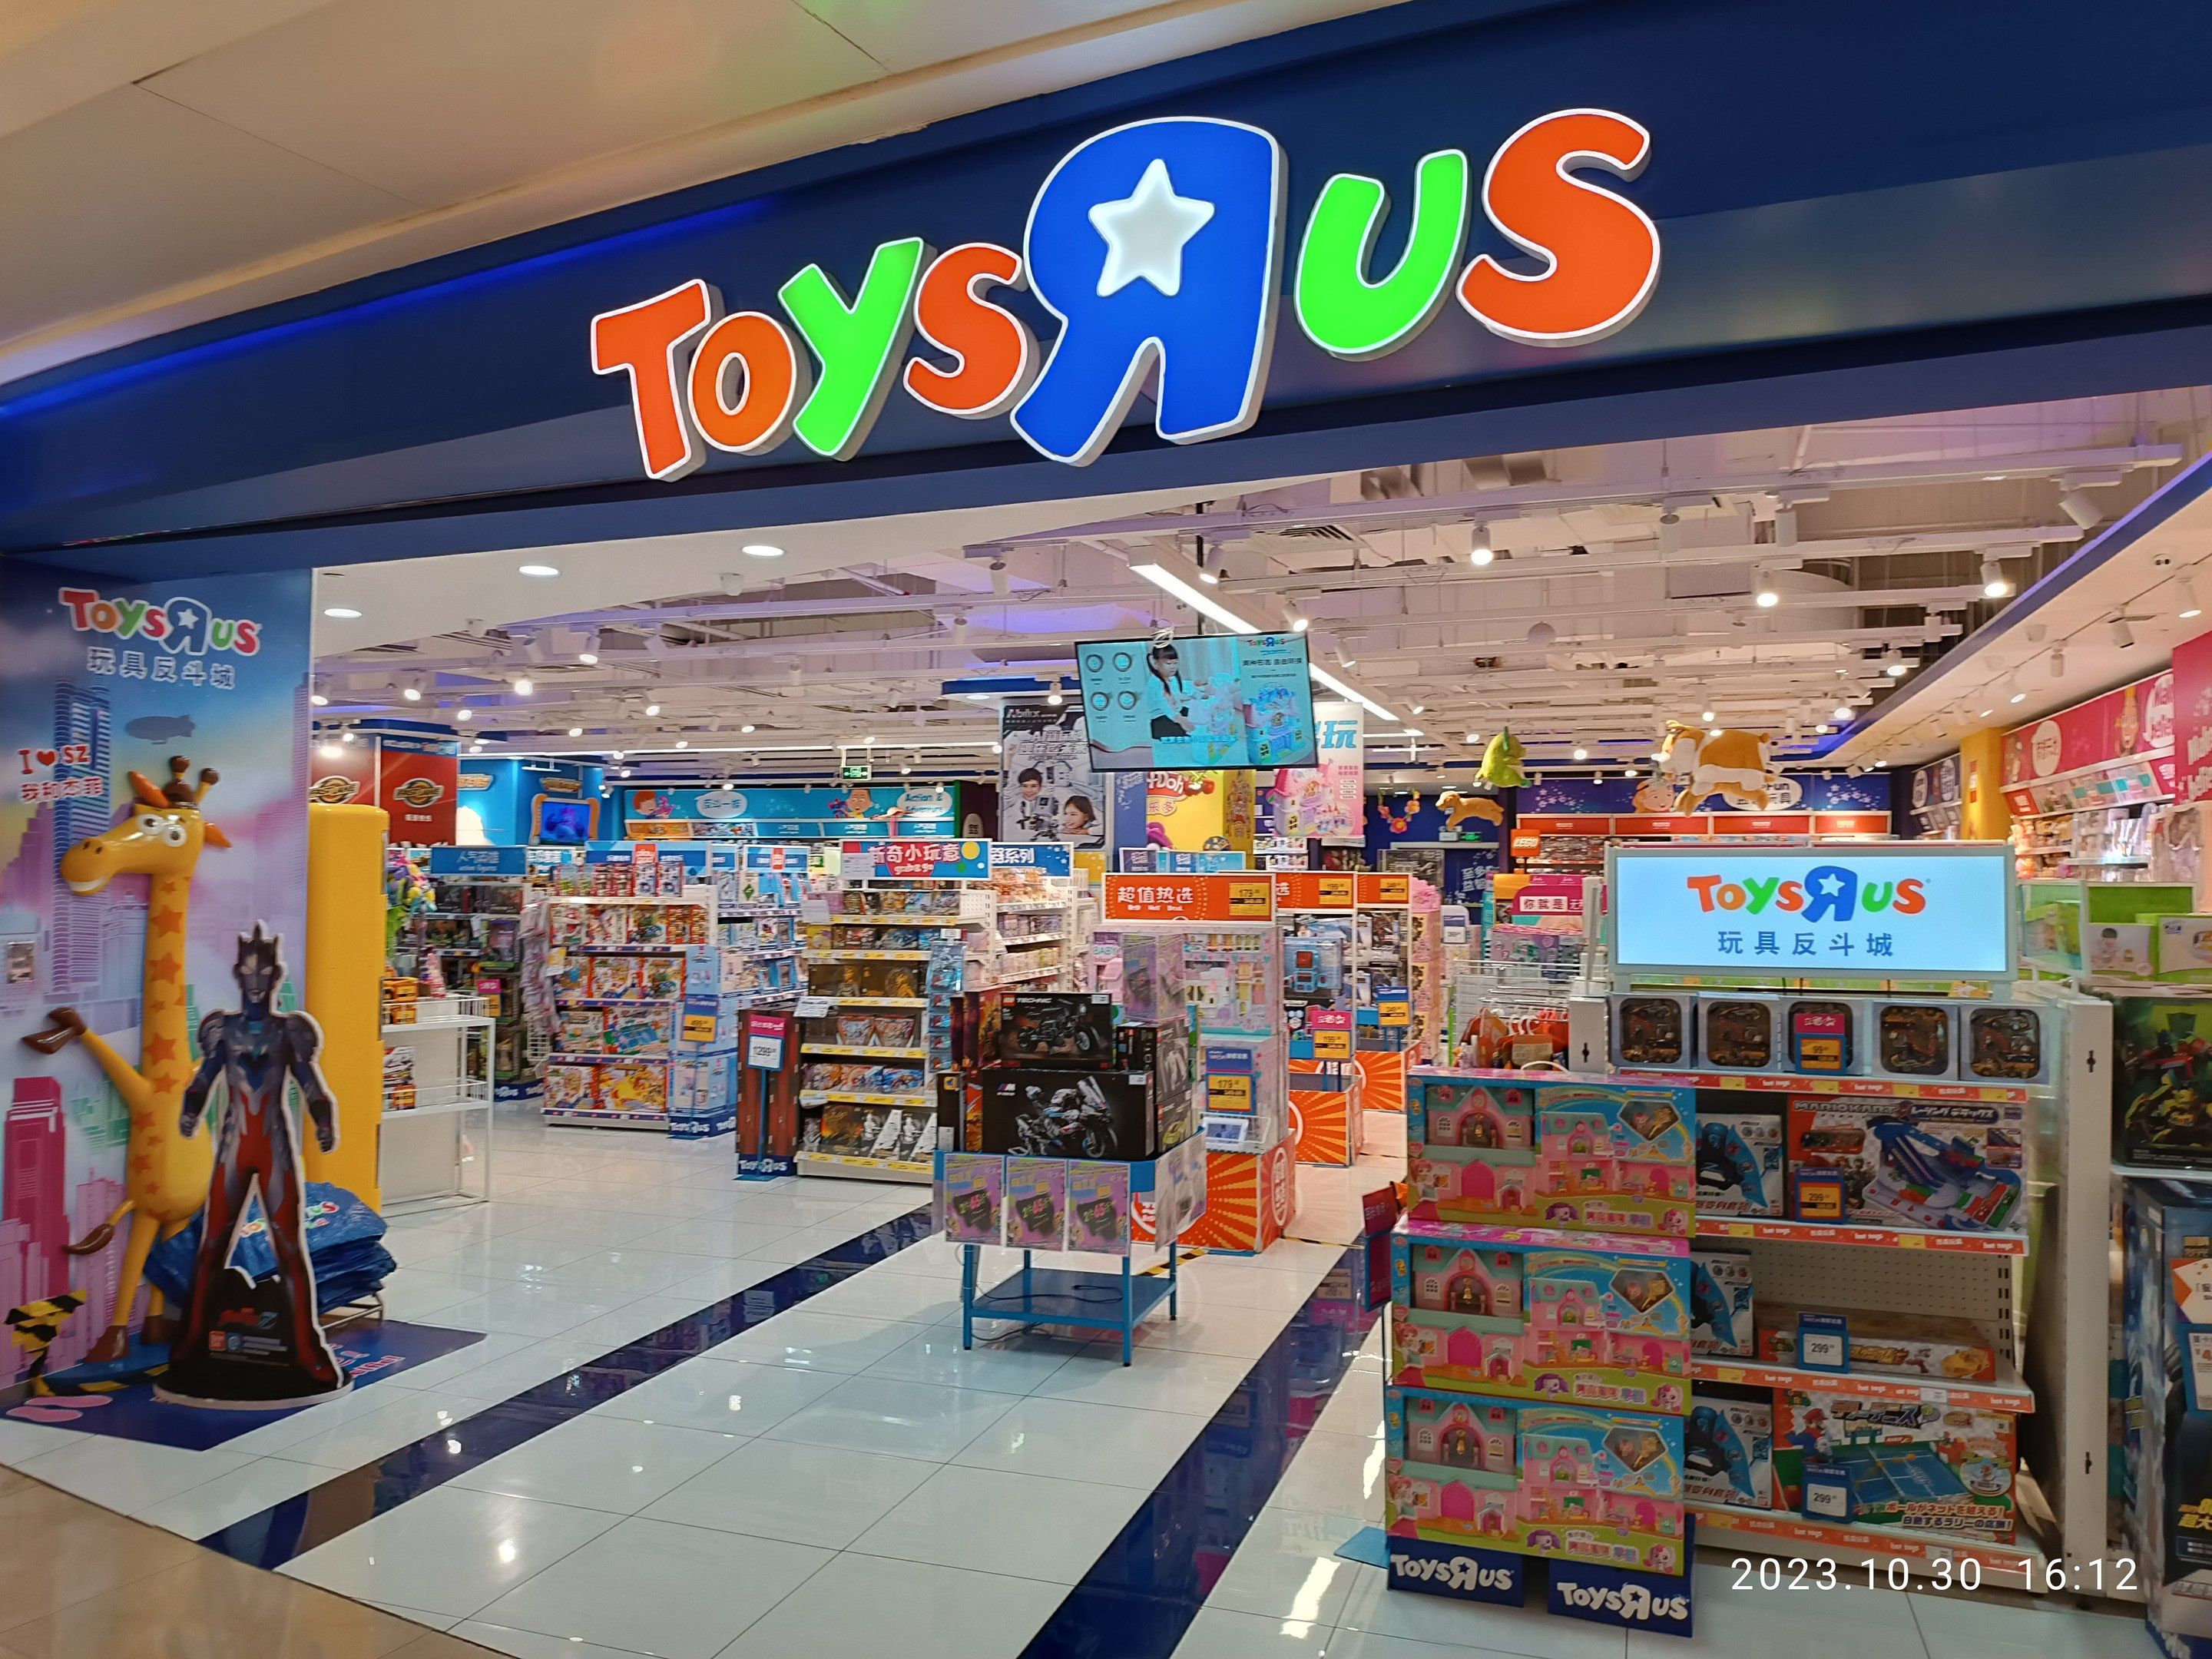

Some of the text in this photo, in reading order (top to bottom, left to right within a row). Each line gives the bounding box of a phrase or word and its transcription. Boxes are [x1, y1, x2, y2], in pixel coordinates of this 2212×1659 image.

[86, 646, 236, 690] 玩具反斗城
[18, 743, 91, 775] I SZ
[1117, 886, 1194, 904] 超值热选
[1717, 931, 1893, 957] 玩具反斗城
